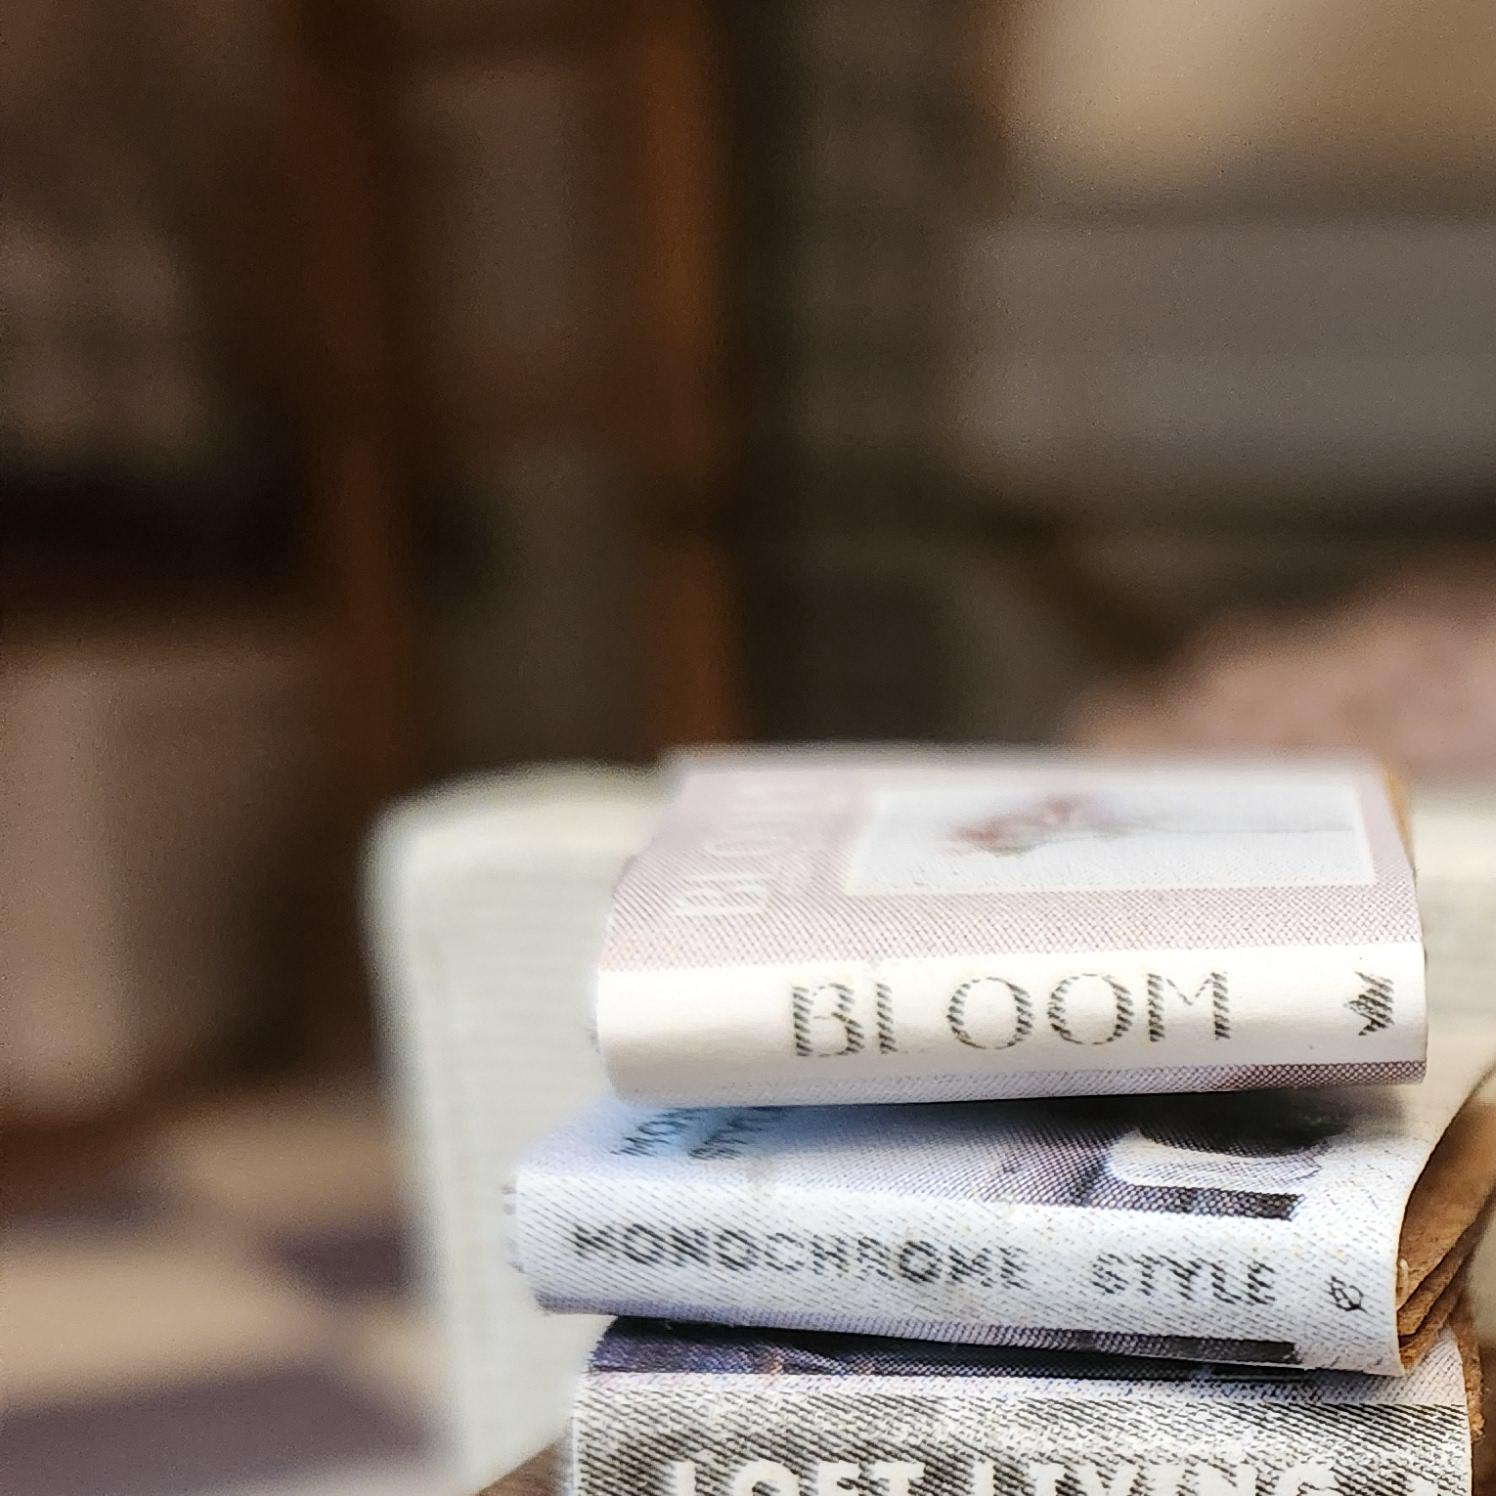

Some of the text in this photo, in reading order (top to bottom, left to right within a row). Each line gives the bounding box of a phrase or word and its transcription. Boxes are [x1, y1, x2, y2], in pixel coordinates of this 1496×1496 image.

[793, 971, 1231, 1058] BLOOM
[572, 1222, 1278, 1308] MONOCHROME STYLE
